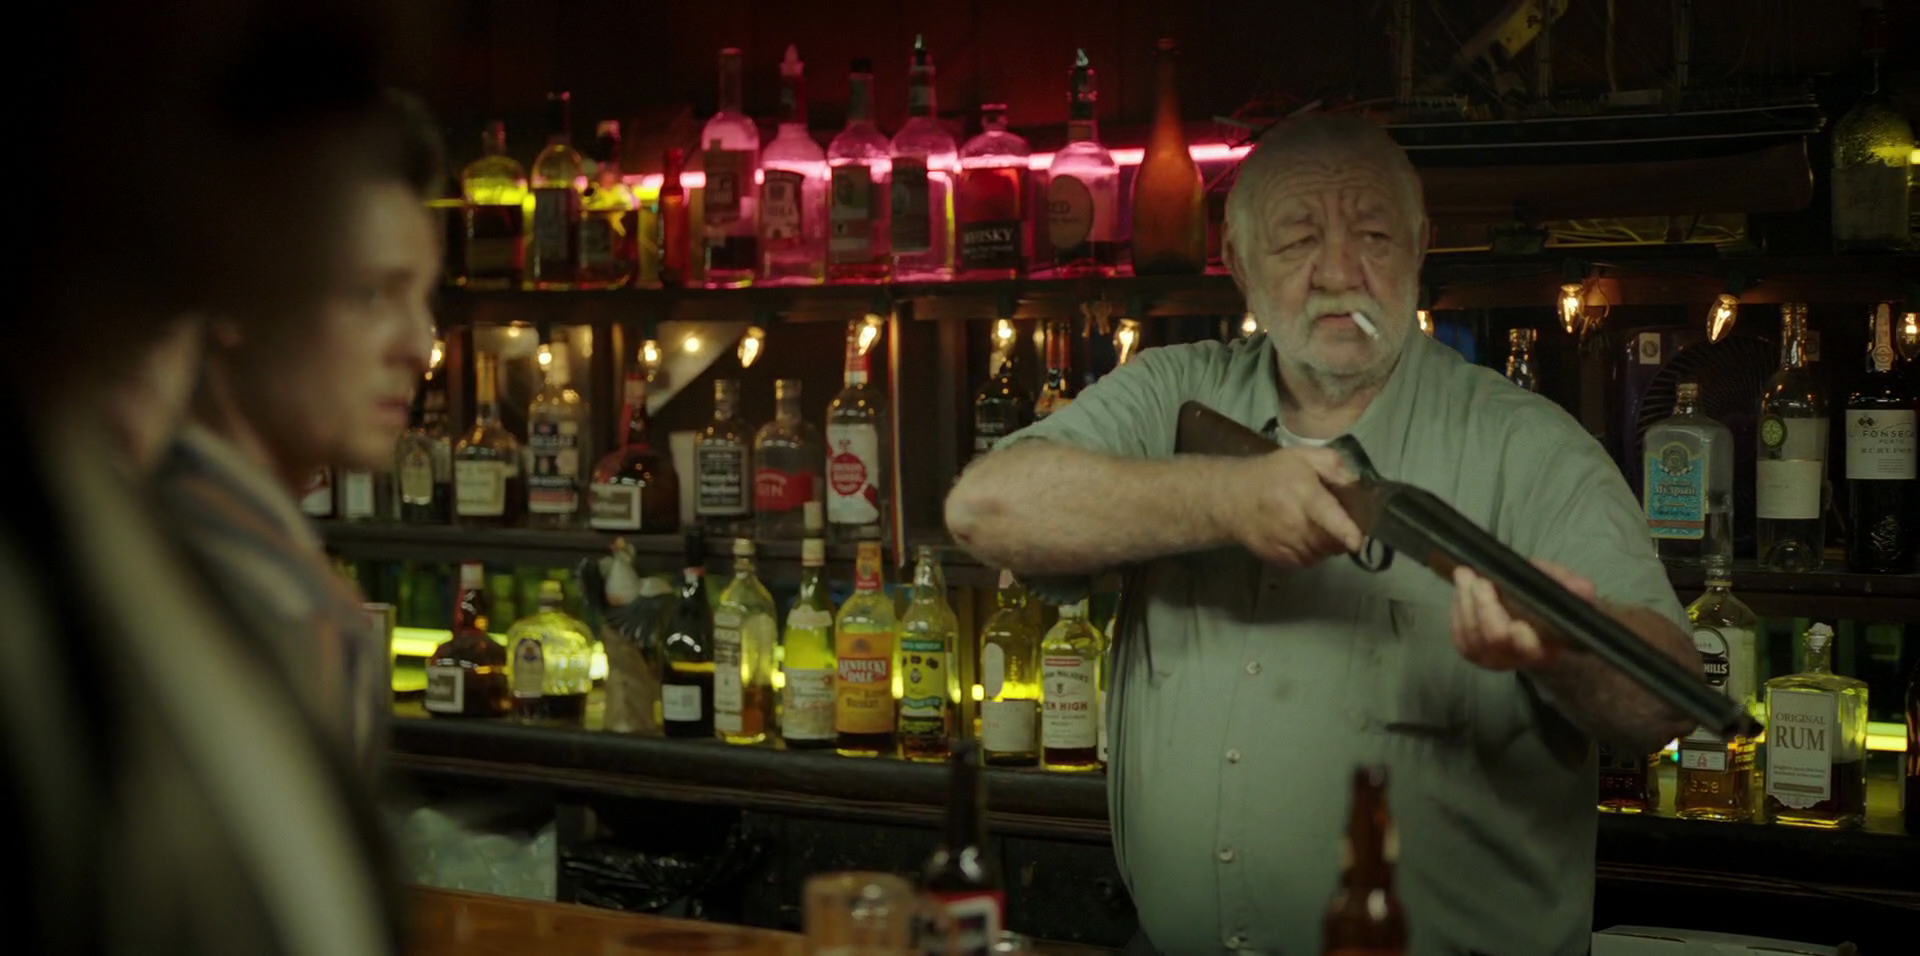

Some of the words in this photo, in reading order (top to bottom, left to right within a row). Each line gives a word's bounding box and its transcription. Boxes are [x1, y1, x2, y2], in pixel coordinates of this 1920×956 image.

[839, 660, 887, 677] KENTUCKY
[847, 671, 874, 683] DALE
[1059, 701, 1088, 711] HIGH
[1776, 711, 1825, 725] ORIGINAL
[1776, 725, 1825, 752] RUM
